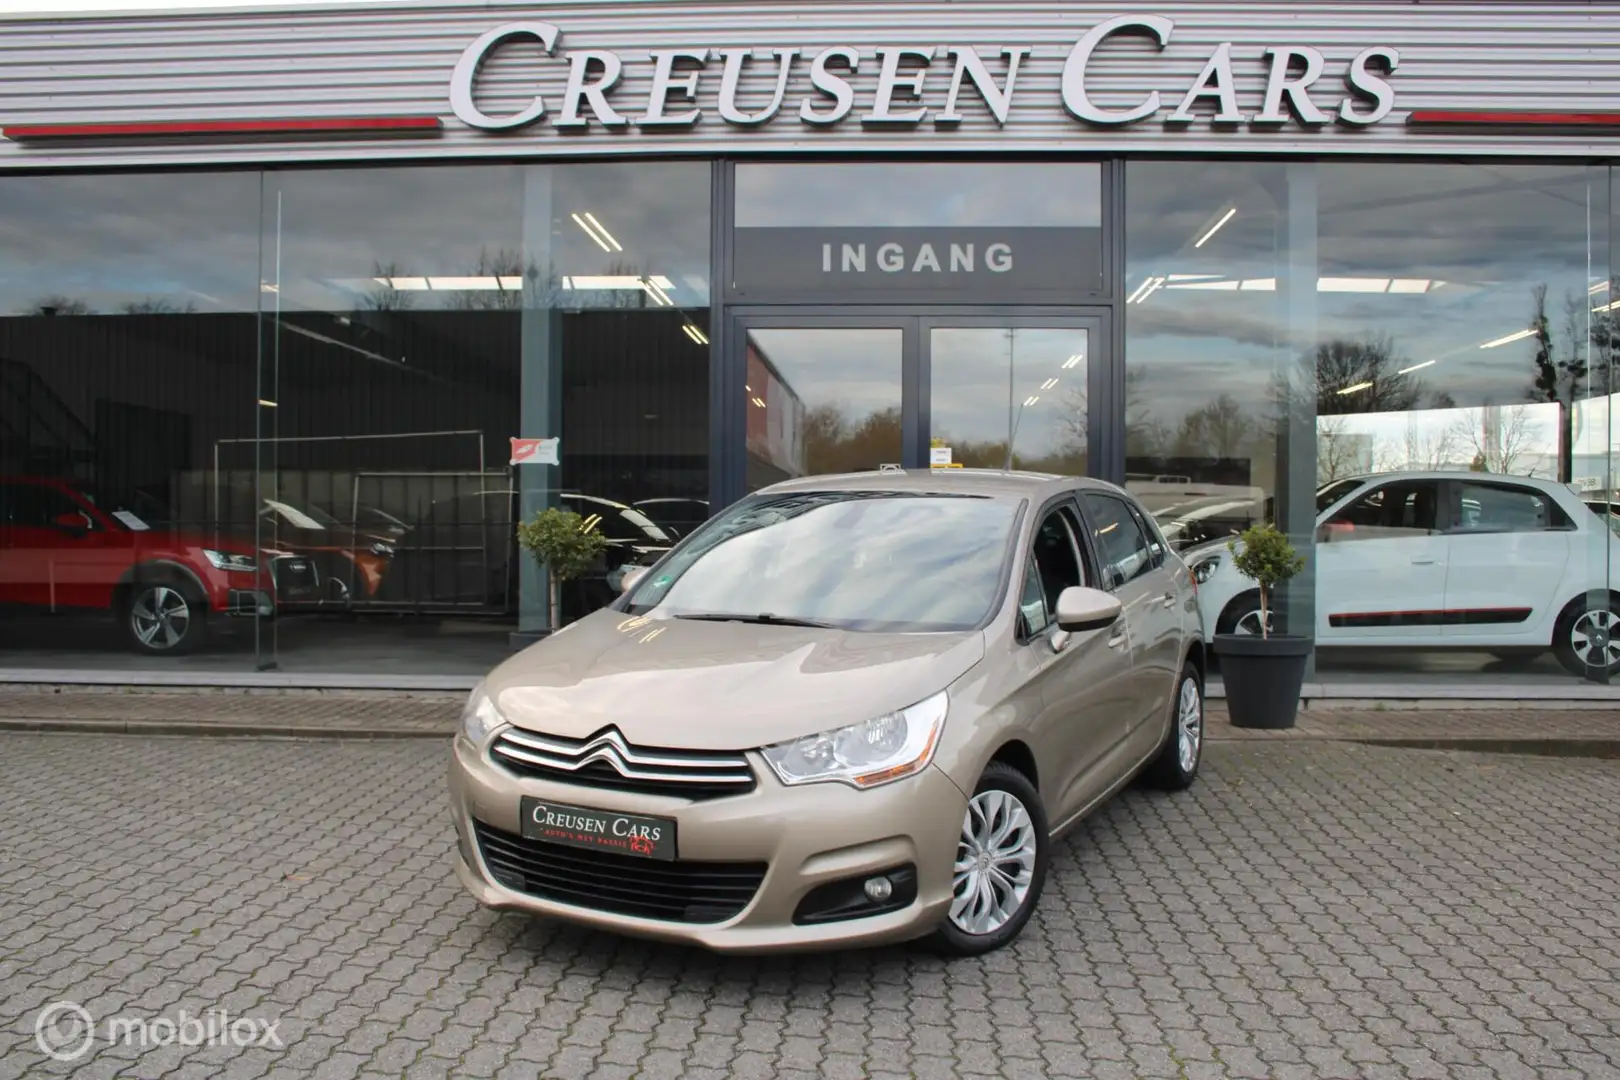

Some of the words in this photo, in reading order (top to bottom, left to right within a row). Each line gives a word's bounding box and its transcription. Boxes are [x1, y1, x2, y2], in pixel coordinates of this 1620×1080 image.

[449, 21, 1032, 131] CREUSEN
[1061, 14, 1399, 125] CARS
[822, 243, 1013, 272] INGANG
[533, 805, 606, 834] CREUSEN
[612, 818, 661, 841] CARS
